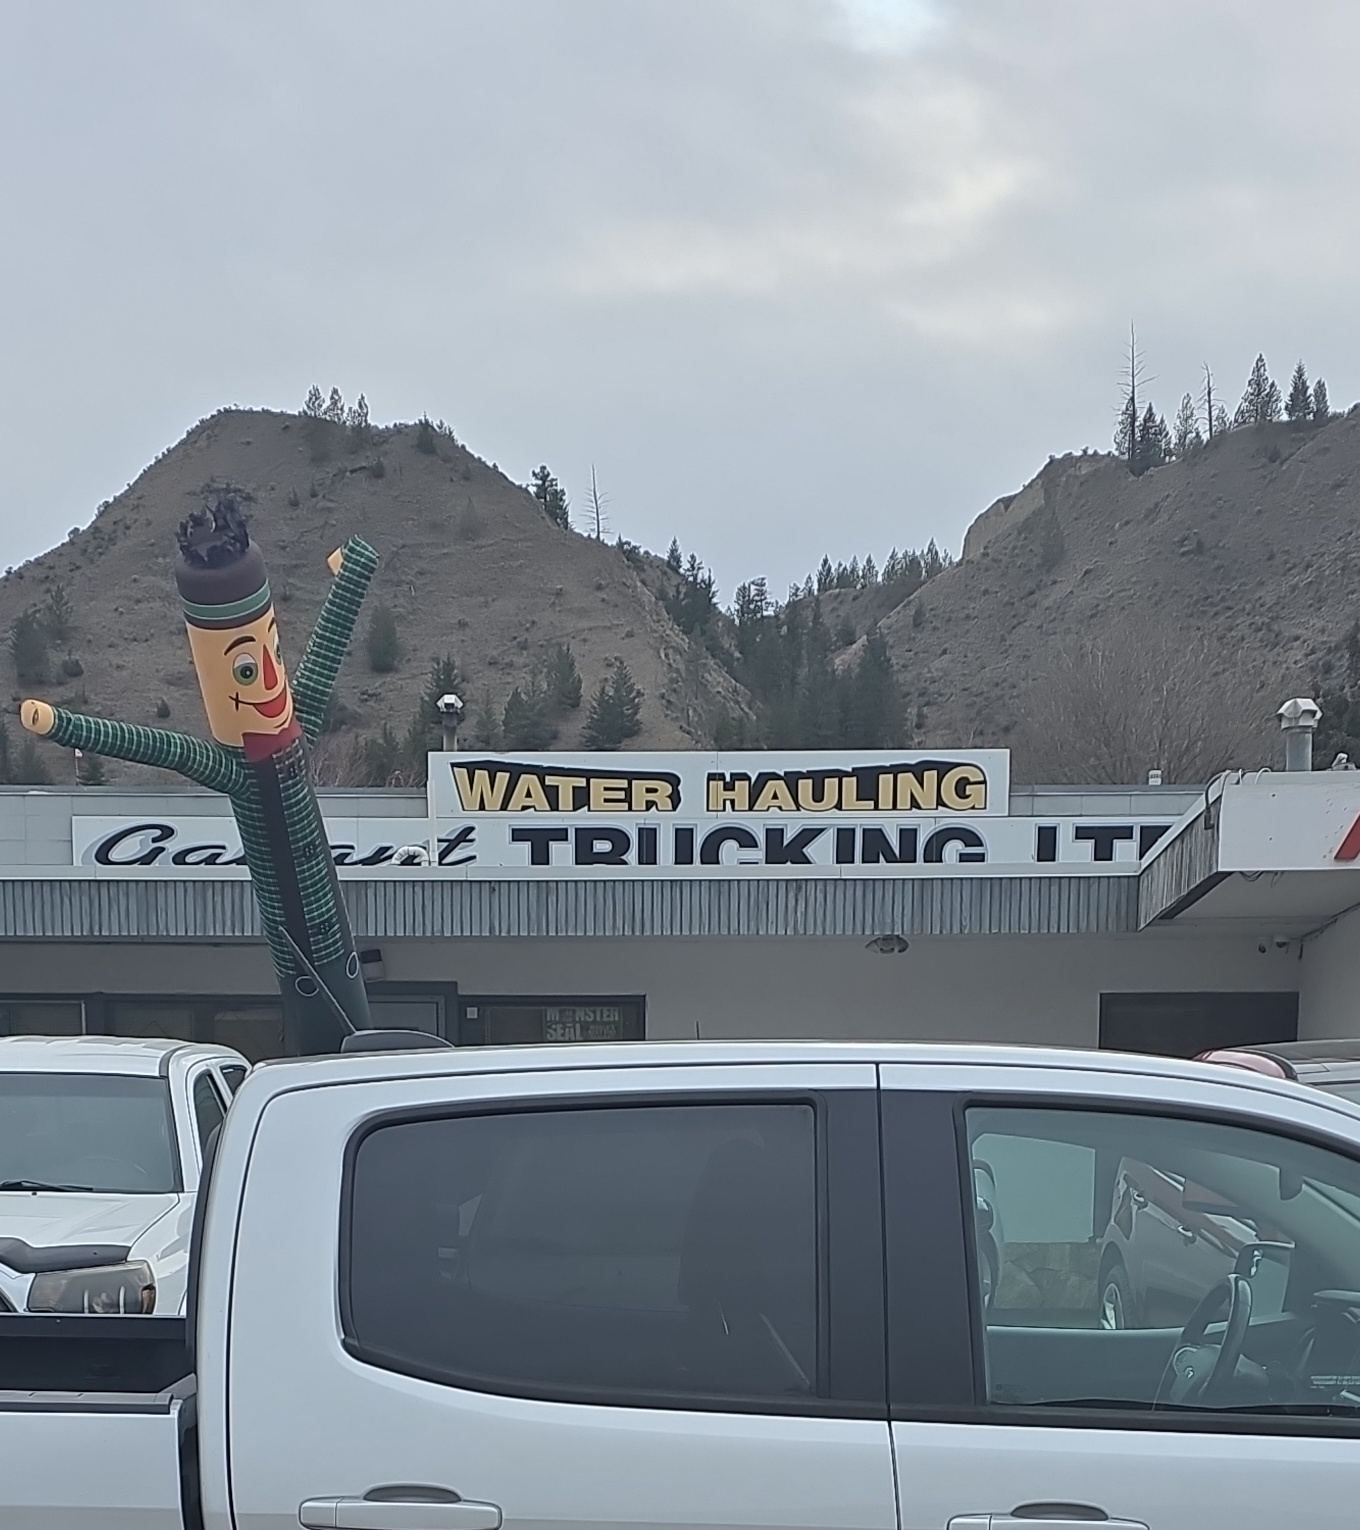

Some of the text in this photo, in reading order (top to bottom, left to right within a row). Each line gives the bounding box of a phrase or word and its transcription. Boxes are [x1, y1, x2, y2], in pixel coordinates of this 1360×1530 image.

[450, 760, 987, 812] WATER HAULING
[511, 825, 986, 866] TRUCKING
